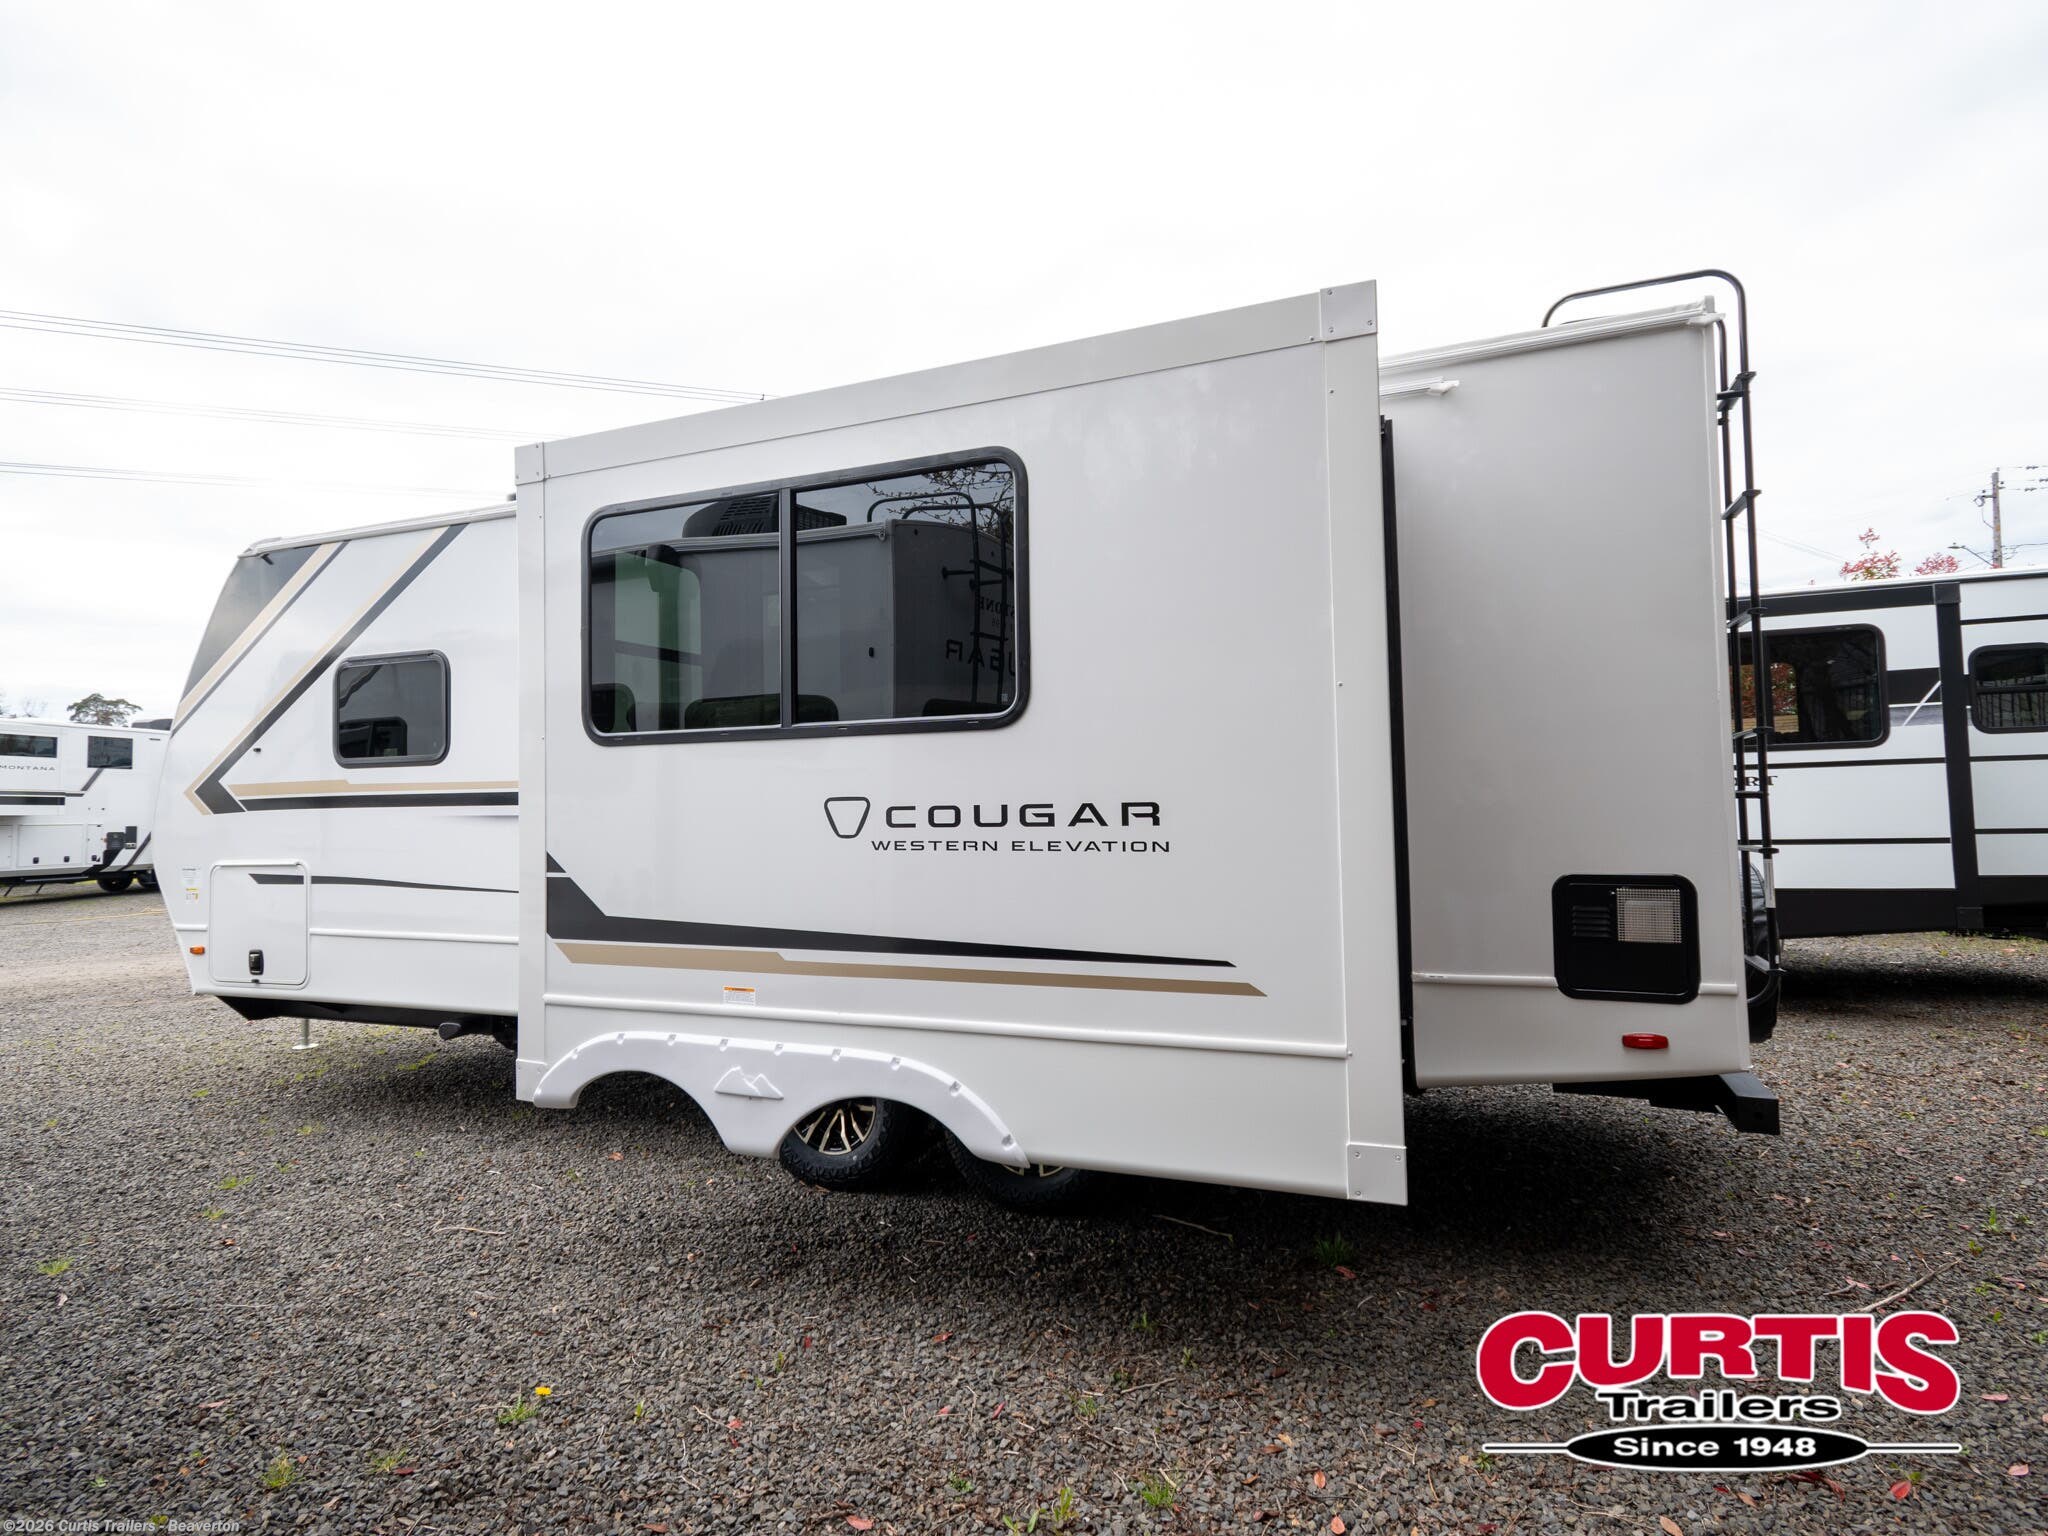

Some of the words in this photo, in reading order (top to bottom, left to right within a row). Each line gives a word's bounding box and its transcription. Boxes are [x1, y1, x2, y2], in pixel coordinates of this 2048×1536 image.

[885, 801, 1161, 829] COUGAR
[871, 840, 999, 852] WESTERN
[1011, 840, 1170, 853] ELEVATION
